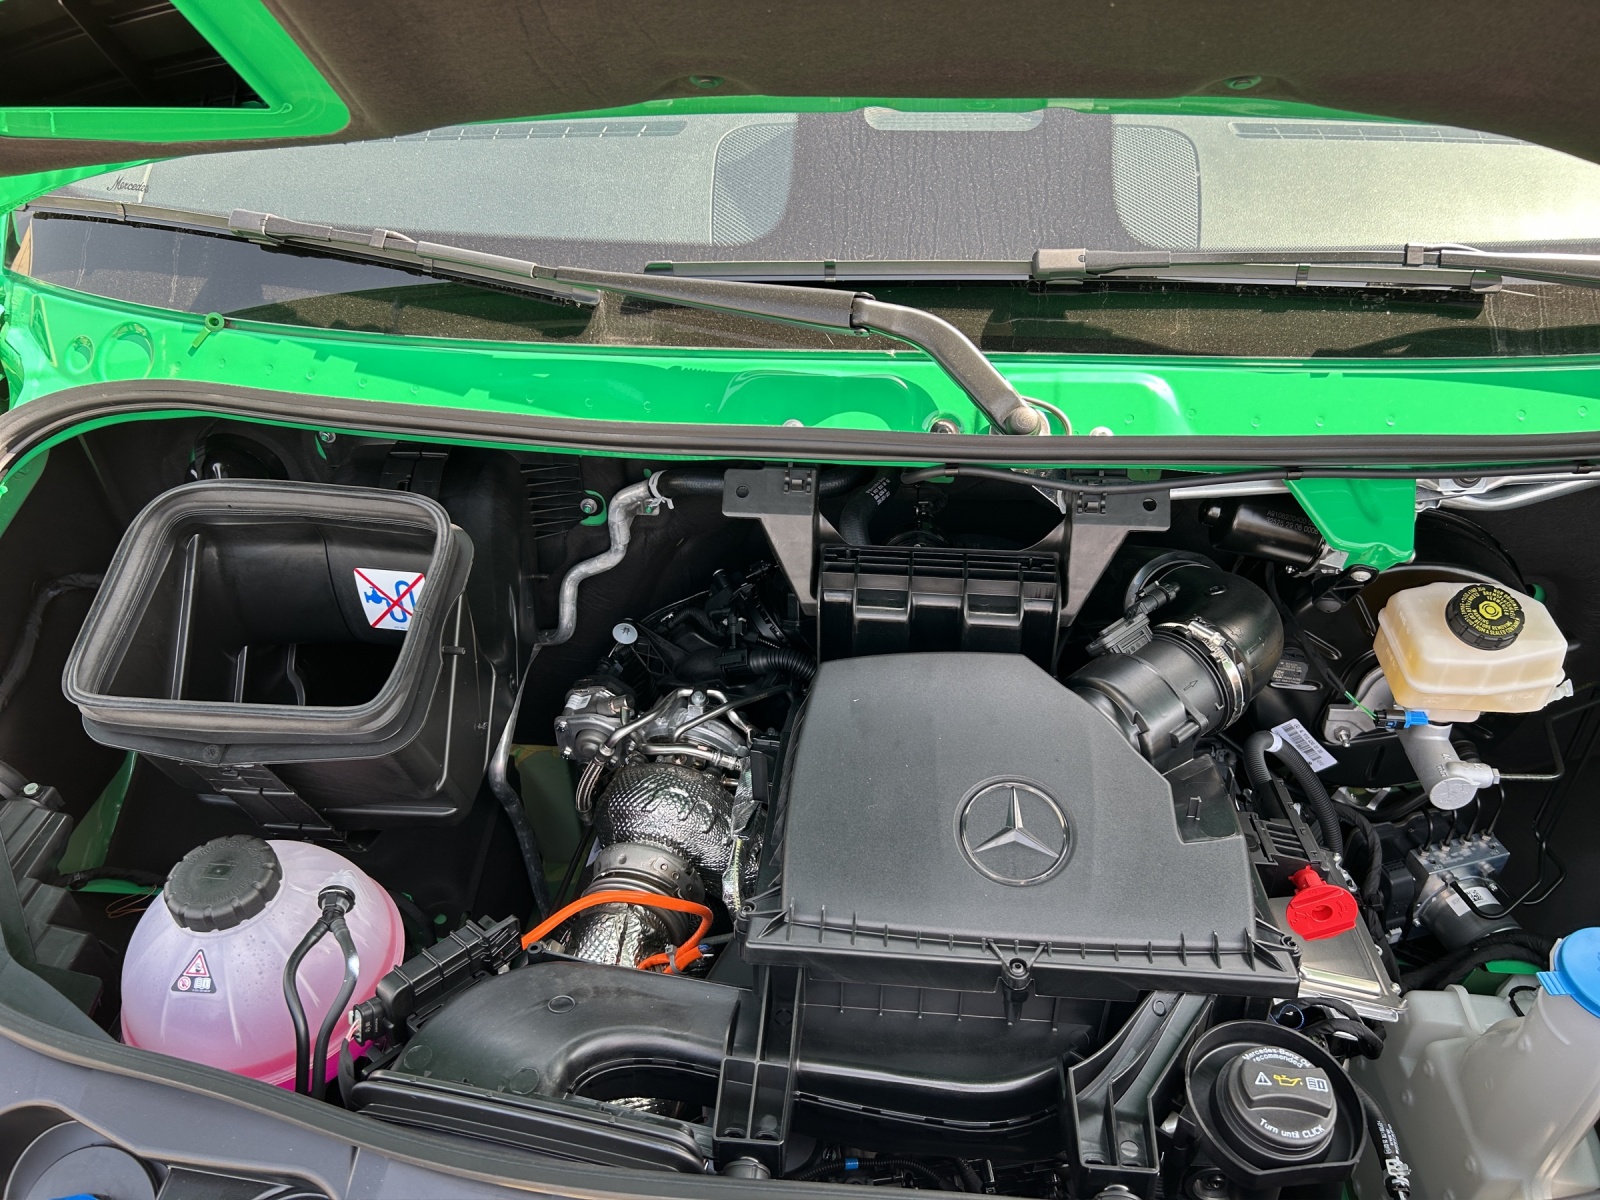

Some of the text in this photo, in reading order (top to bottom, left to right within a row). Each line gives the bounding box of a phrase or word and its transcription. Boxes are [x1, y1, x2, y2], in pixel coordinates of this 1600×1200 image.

[106, 175, 149, 193] Mercedes
[1242, 1047, 1299, 1061] Mercedes-Benz
[1252, 1053, 1303, 1068] recommended
[1259, 1118, 1326, 1139] Turn until CLICK
